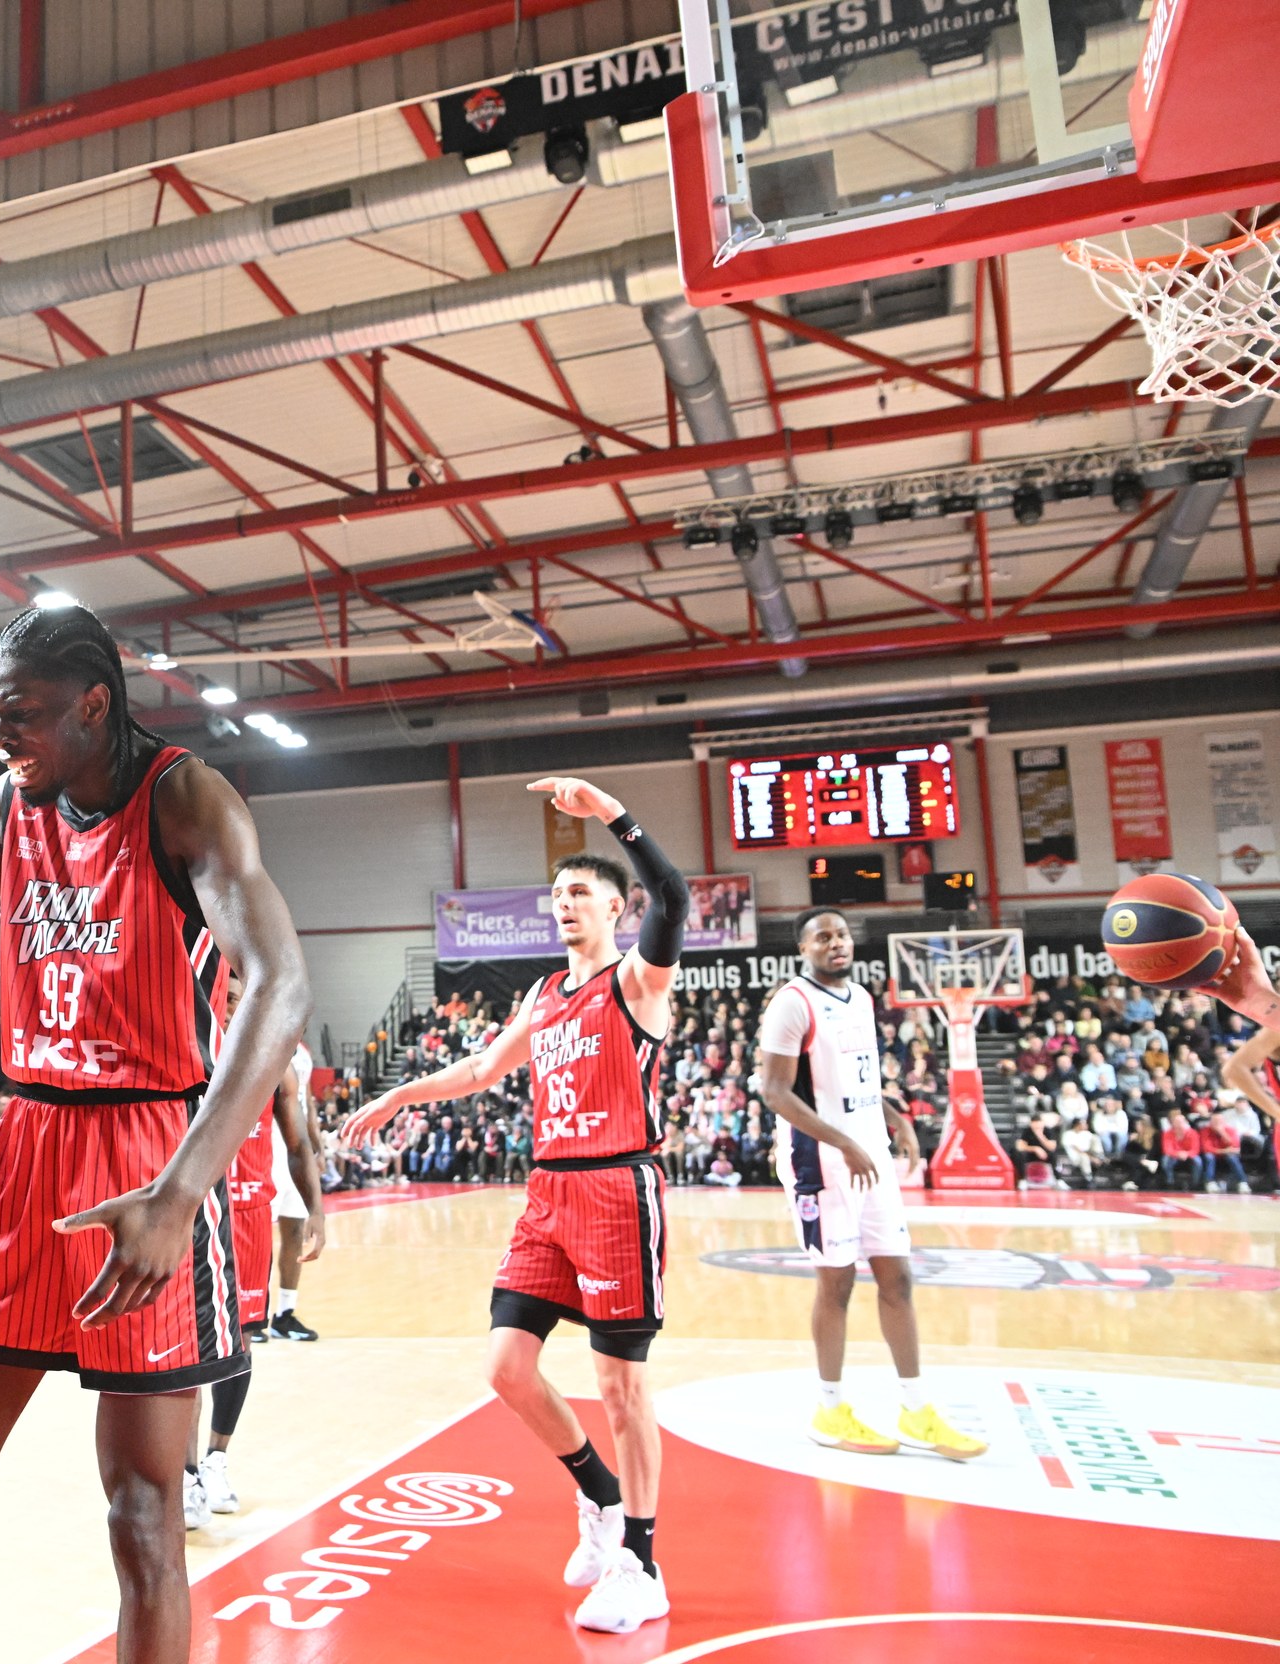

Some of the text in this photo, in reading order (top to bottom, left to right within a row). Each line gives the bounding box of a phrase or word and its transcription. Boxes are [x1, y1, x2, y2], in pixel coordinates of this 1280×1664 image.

[756, 0, 894, 52] C'EST
[773, 1, 1017, 71] www.denain-voltaire.f
[1142, 0, 1169, 94] SPOR
[540, 42, 686, 105] DENAI
[10, 879, 99, 924] DENAIN
[467, 912, 515, 931] Fiers
[18, 918, 122, 964] VOLTAIRE
[456, 928, 551, 947] Denaisiens
[674, 958, 741, 990] epuis
[1030, 945, 1069, 979] du
[39, 961, 84, 1030] 93
[12, 1028, 122, 1075] SKF
[531, 1018, 581, 1060] DENAIN
[535, 1033, 602, 1083] VOLTAIRE
[546, 1071, 576, 1114] 66
[538, 1111, 608, 1142] SKF
[212, 1523, 431, 1630] suez
